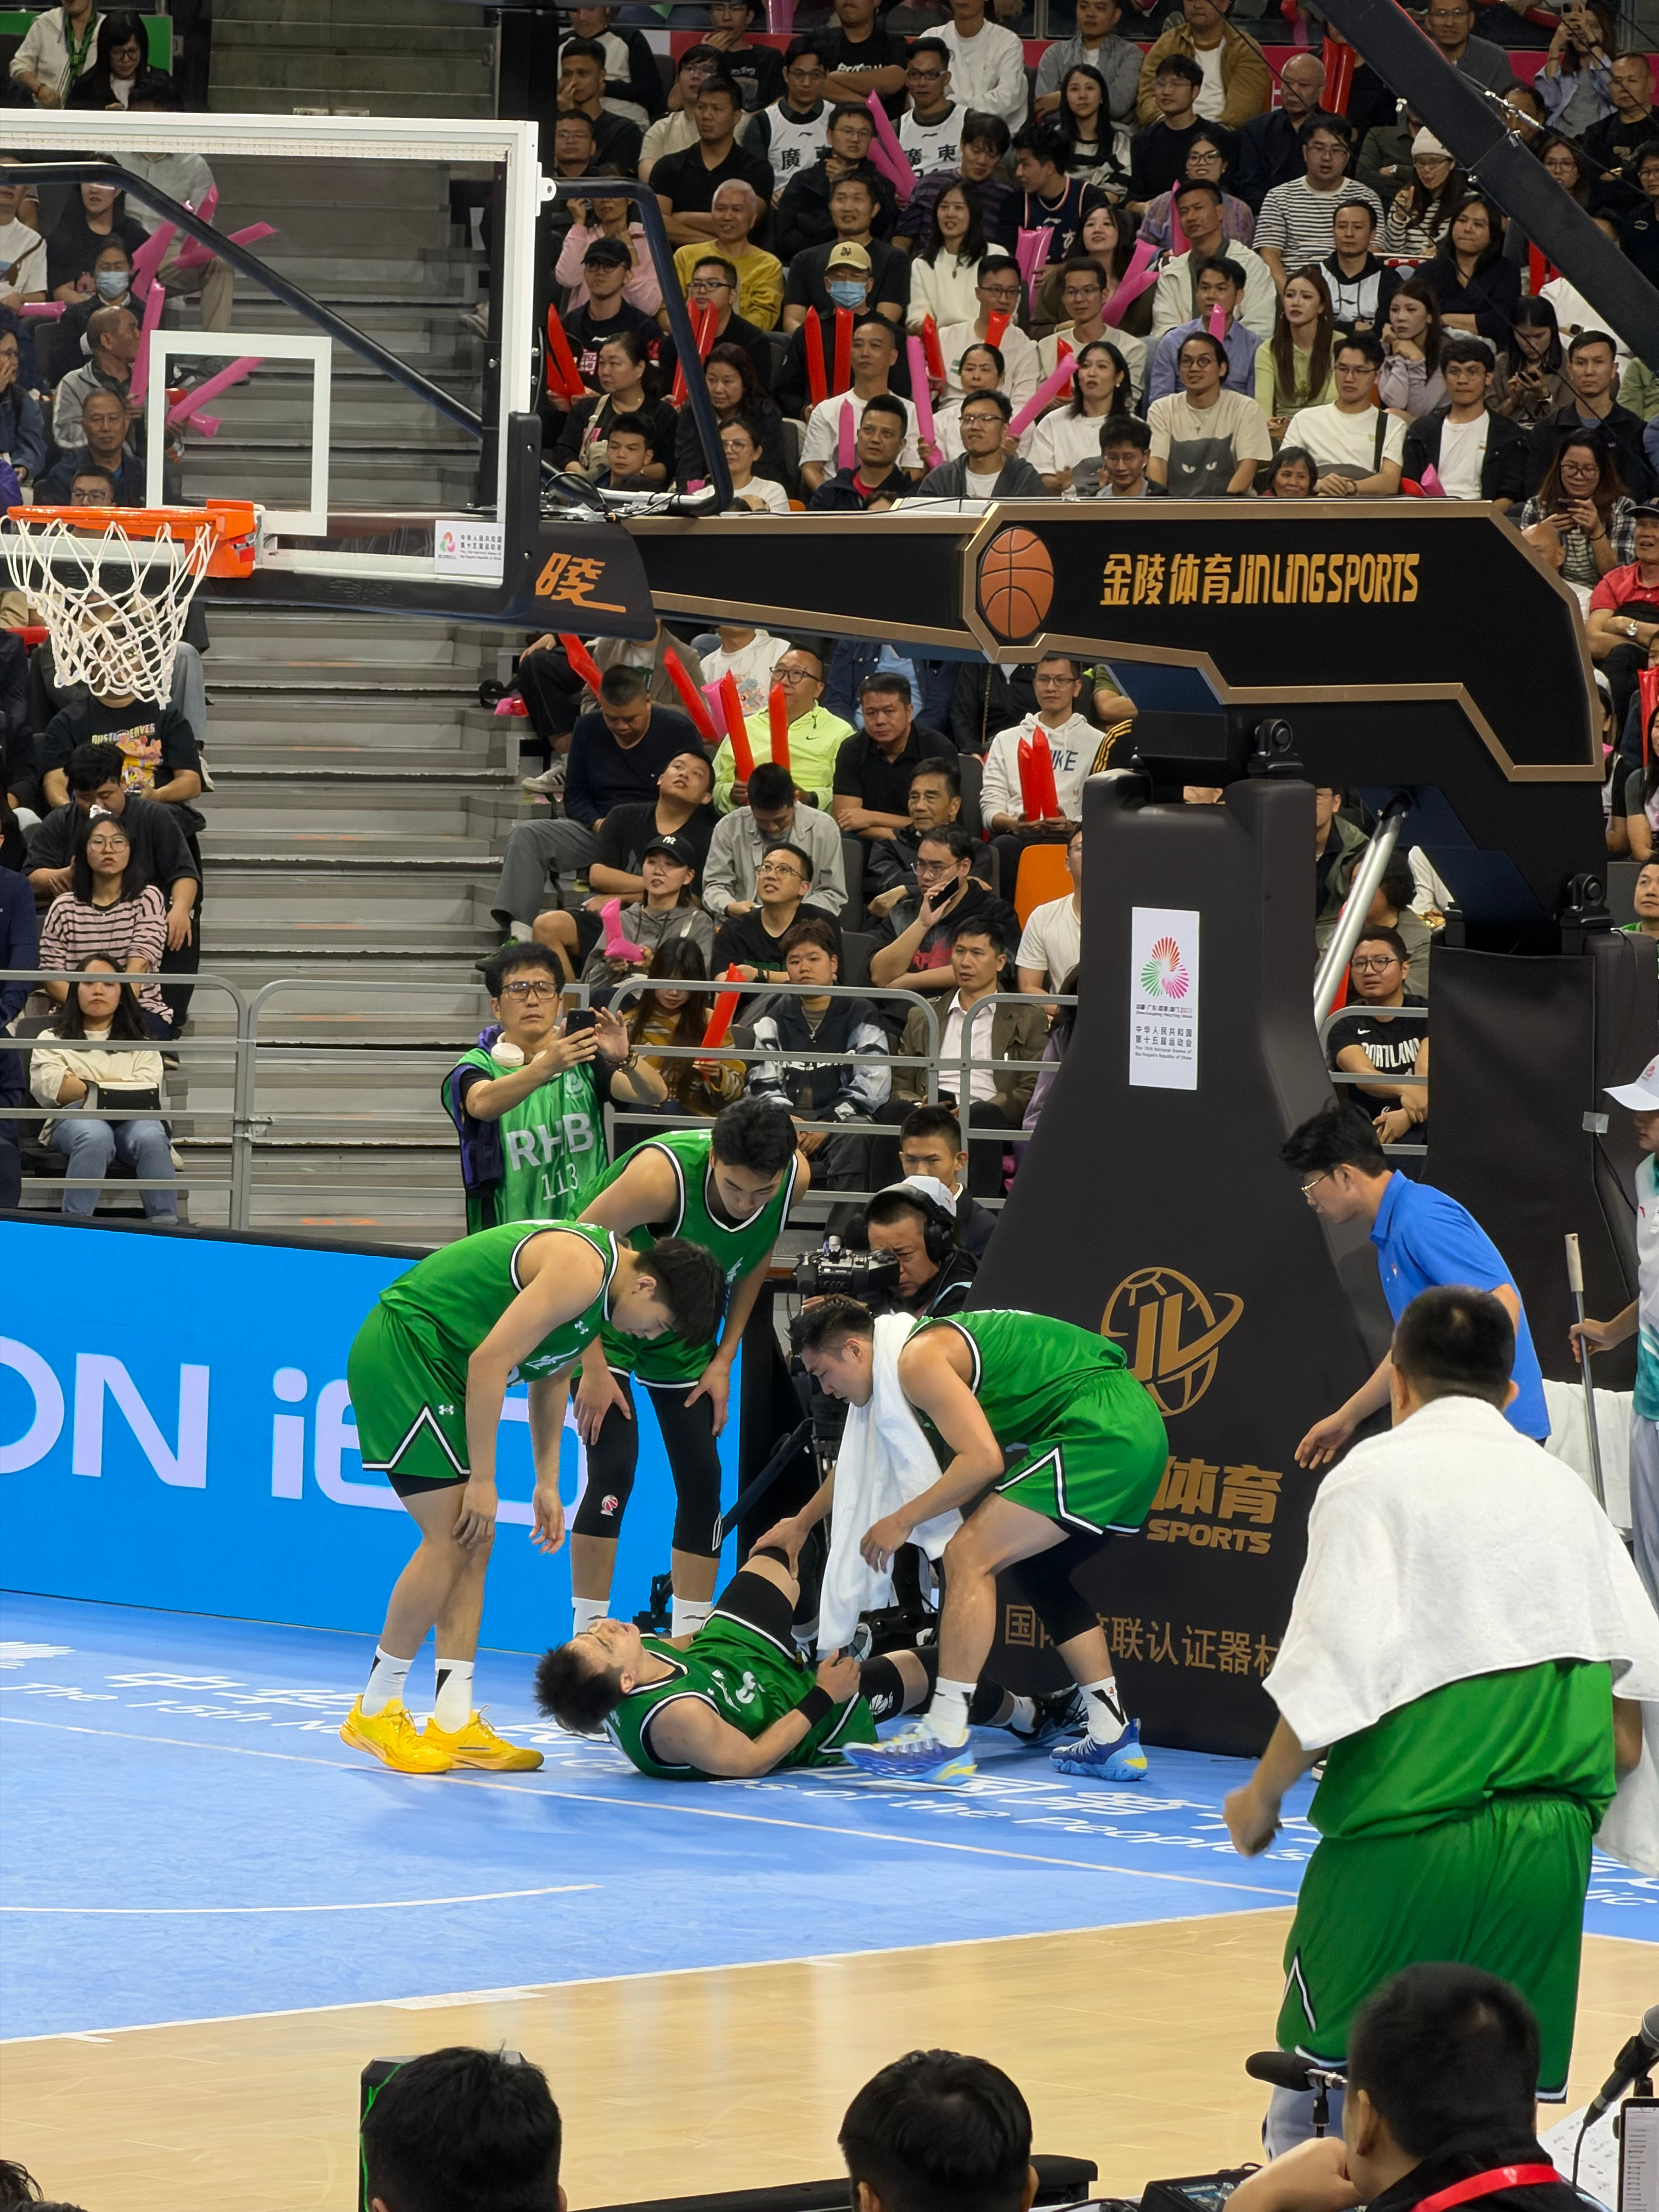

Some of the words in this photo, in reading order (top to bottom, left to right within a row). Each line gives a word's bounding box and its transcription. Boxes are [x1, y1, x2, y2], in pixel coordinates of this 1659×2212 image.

[535, 552, 627, 613] 陵
[1100, 553, 1233, 605] 金陵体育
[1052, 749, 1079, 771] IKE
[506, 1113, 594, 1171] RHB
[541, 1163, 579, 1200] 113
[1147, 1519, 1272, 1554] SPORTS
[1005, 1604, 1284, 1677] 国联认证器材
